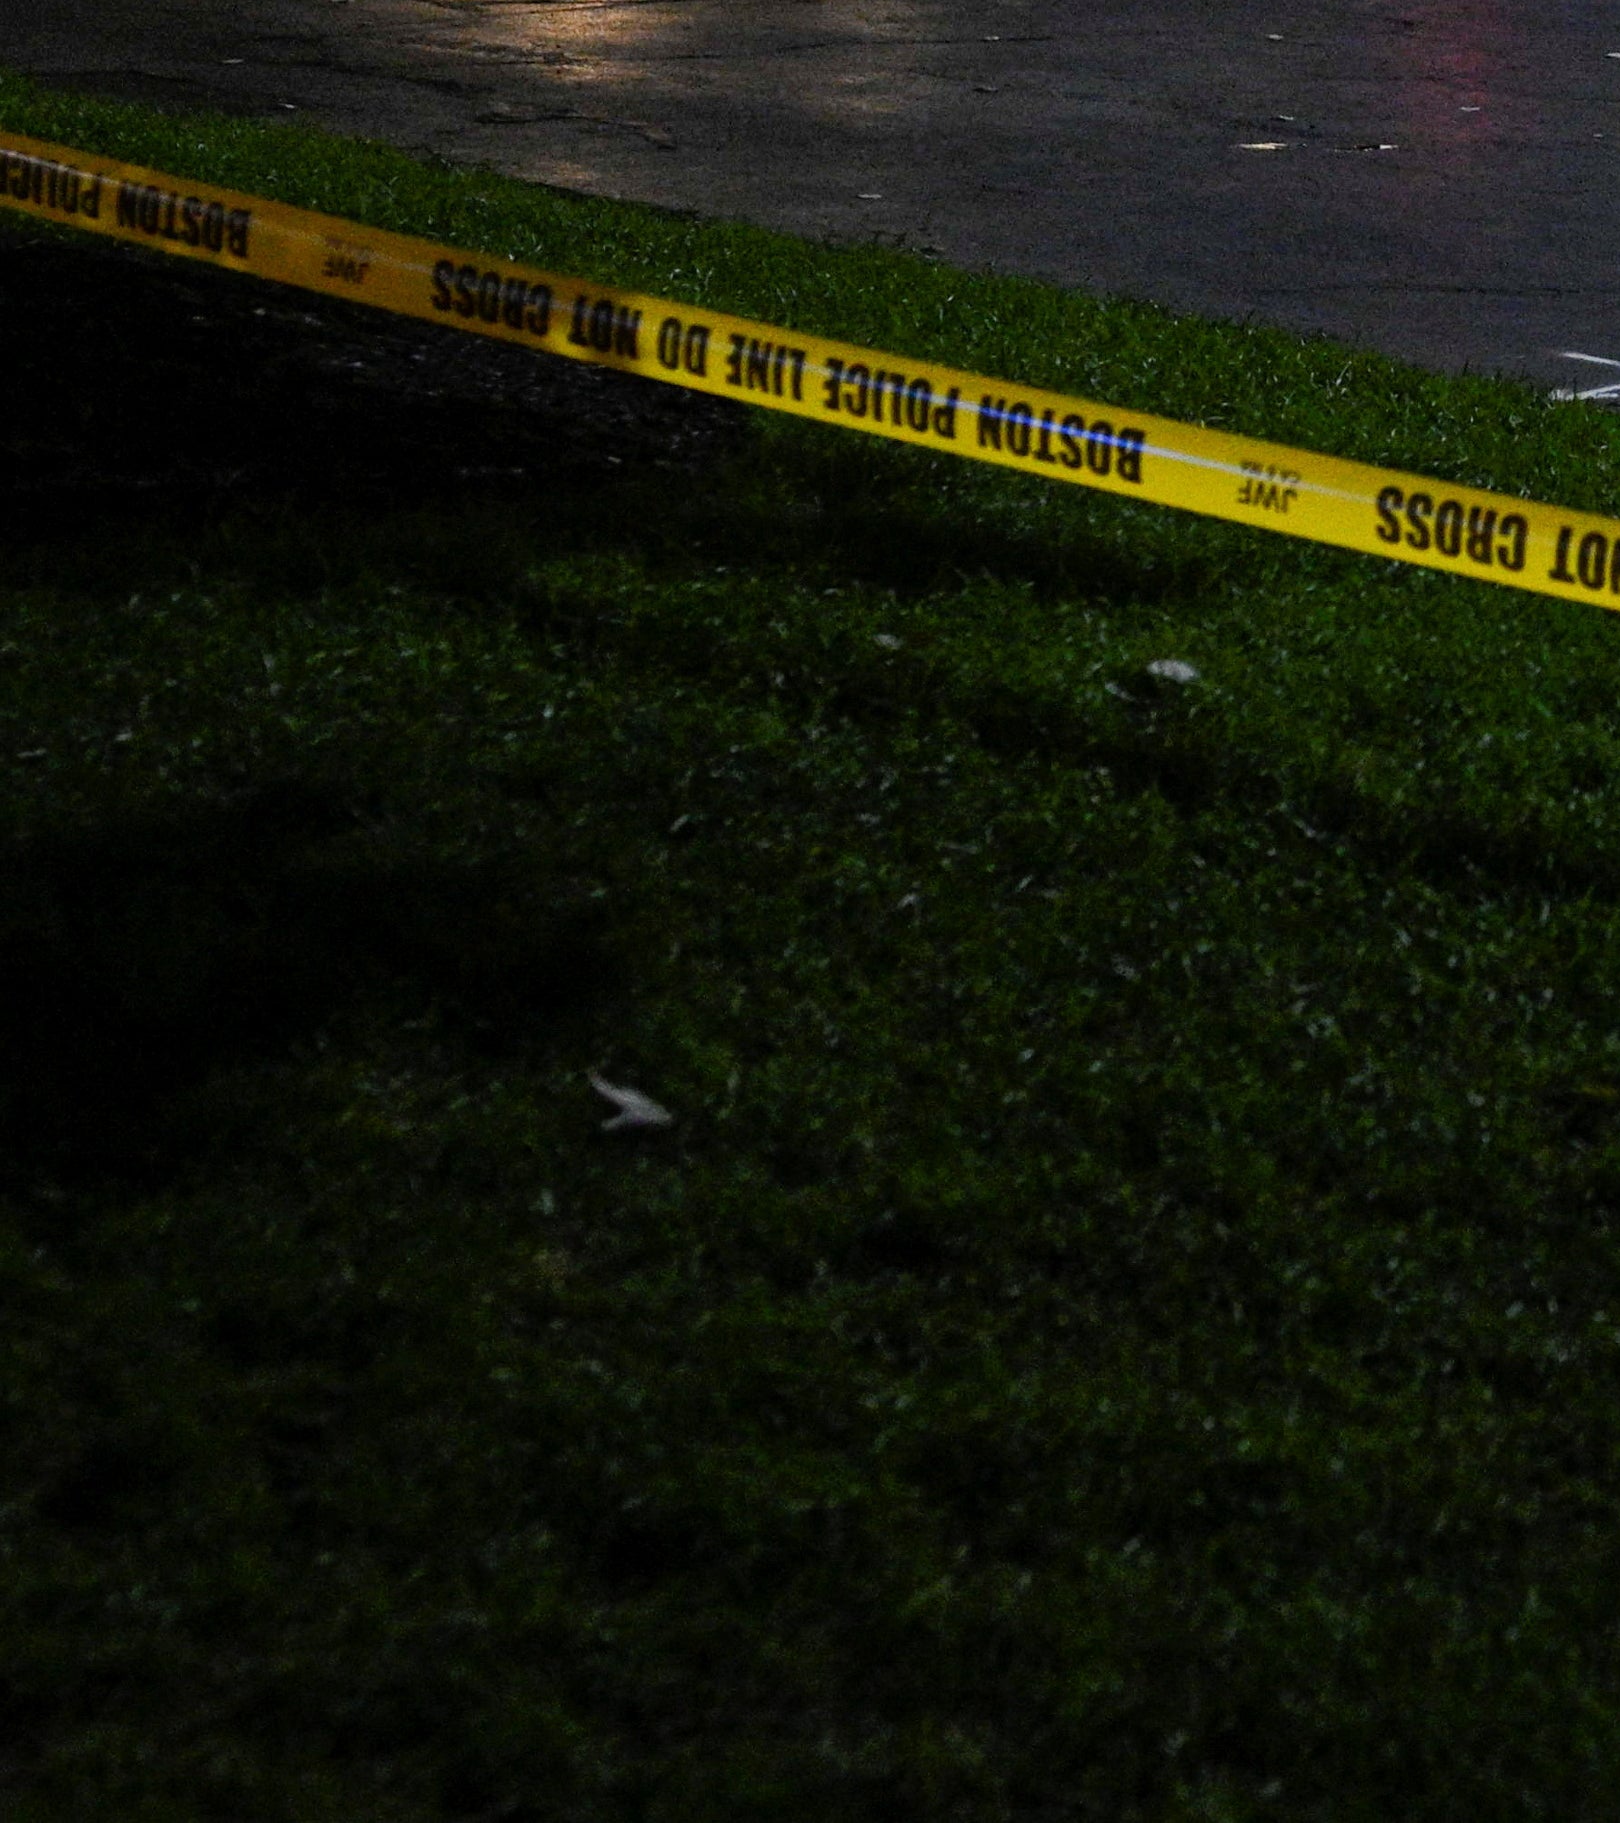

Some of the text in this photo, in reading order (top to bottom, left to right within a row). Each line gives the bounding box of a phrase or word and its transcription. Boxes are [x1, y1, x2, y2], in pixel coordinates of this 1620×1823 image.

[116, 182, 252, 259] BOSTON
[429, 259, 1147, 485] BOSTON POLICE LINE DO NOT CROSS
[1237, 479, 1299, 515] JWF
[1375, 485, 1529, 573] CROSS
